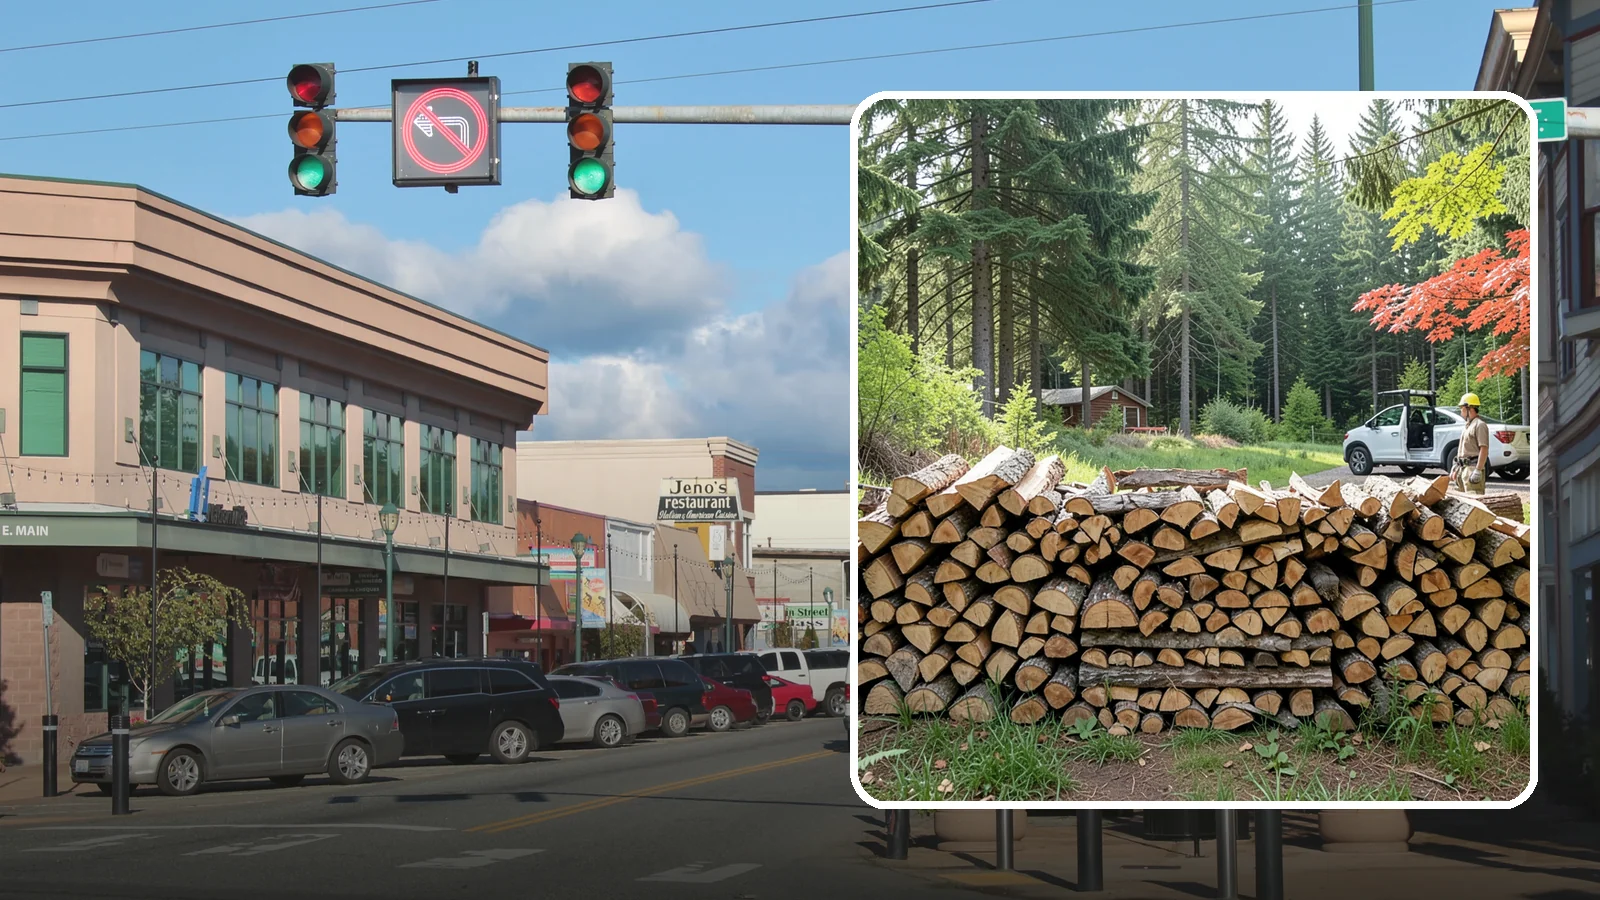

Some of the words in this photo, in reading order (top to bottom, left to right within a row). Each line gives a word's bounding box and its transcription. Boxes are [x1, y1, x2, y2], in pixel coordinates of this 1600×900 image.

[670, 480, 727, 495] Jeno's
[665, 496, 731, 509] restaurant
[659, 510, 681, 519] Italian
[686, 510, 714, 519] American
[715, 510, 737, 519] Cuisine
[2, 525, 13, 536] E.
[15, 525, 49, 536] MAIN
[797, 607, 828, 617] Street
[791, 619, 824, 627] lass
